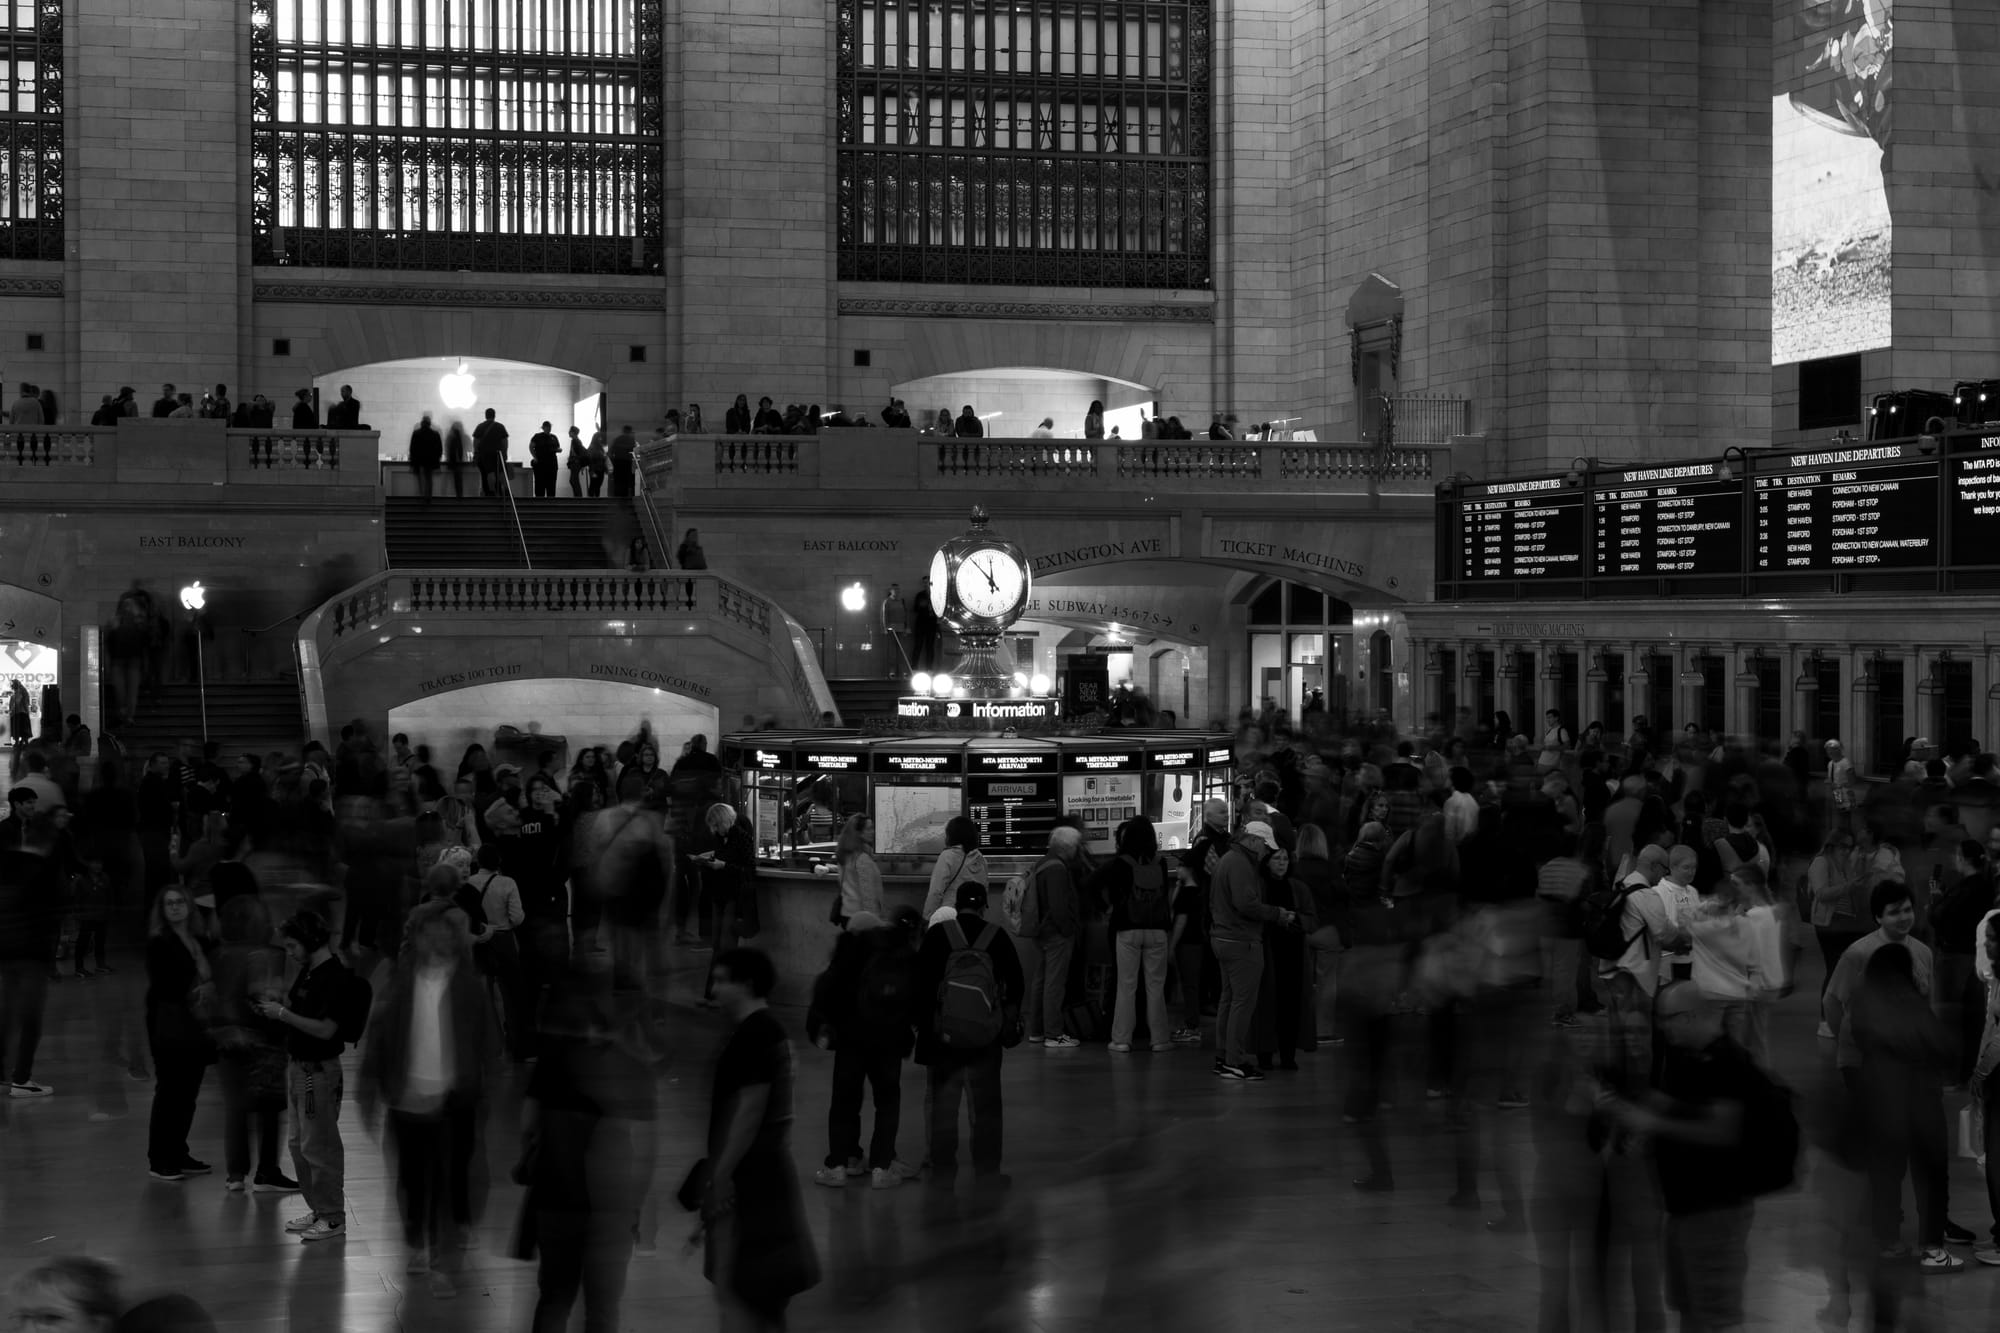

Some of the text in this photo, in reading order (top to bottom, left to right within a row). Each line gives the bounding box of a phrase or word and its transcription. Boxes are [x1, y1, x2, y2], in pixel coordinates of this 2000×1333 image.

[1981, 437, 2000, 449] INFO
[1791, 446, 1901, 467] NEW HAVEN LINE DEPARTURES
[1963, 461, 1973, 470] The
[1973, 459, 1986, 469] MTA
[1624, 464, 1713, 482] NEW HAVEN LINE DEPARTURES
[1832, 472, 1857, 481] REMARKS
[1487, 479, 1560, 495] NEW HAVEN LINE DEPARTURES
[1756, 475, 1821, 488] TIME TRK DESTINATION
[1832, 486, 1861, 495] CONNECTION
[1862, 485, 1868, 493] TO
[1960, 490, 1977, 501] Thank
[140, 536, 246, 548] EAST BALCONY
[803, 540, 899, 551] EAST BALCONY
[1832, 541, 1861, 550] CONNECTION
[1032, 539, 1161, 572] EXINGTON AVE
[1221, 539, 1364, 578] TICKET MACHINES
[987, 602, 994, 612] 6
[1048, 600, 1108, 615] SUBWAY
[1548, 623, 1585, 636] MACHINES
[419, 664, 522, 693] TRACKS 100 TO 117
[590, 663, 711, 697] DINING CONCOURSE
[973, 702, 1046, 717] Information
[991, 785, 1034, 793] ARRIVALS
